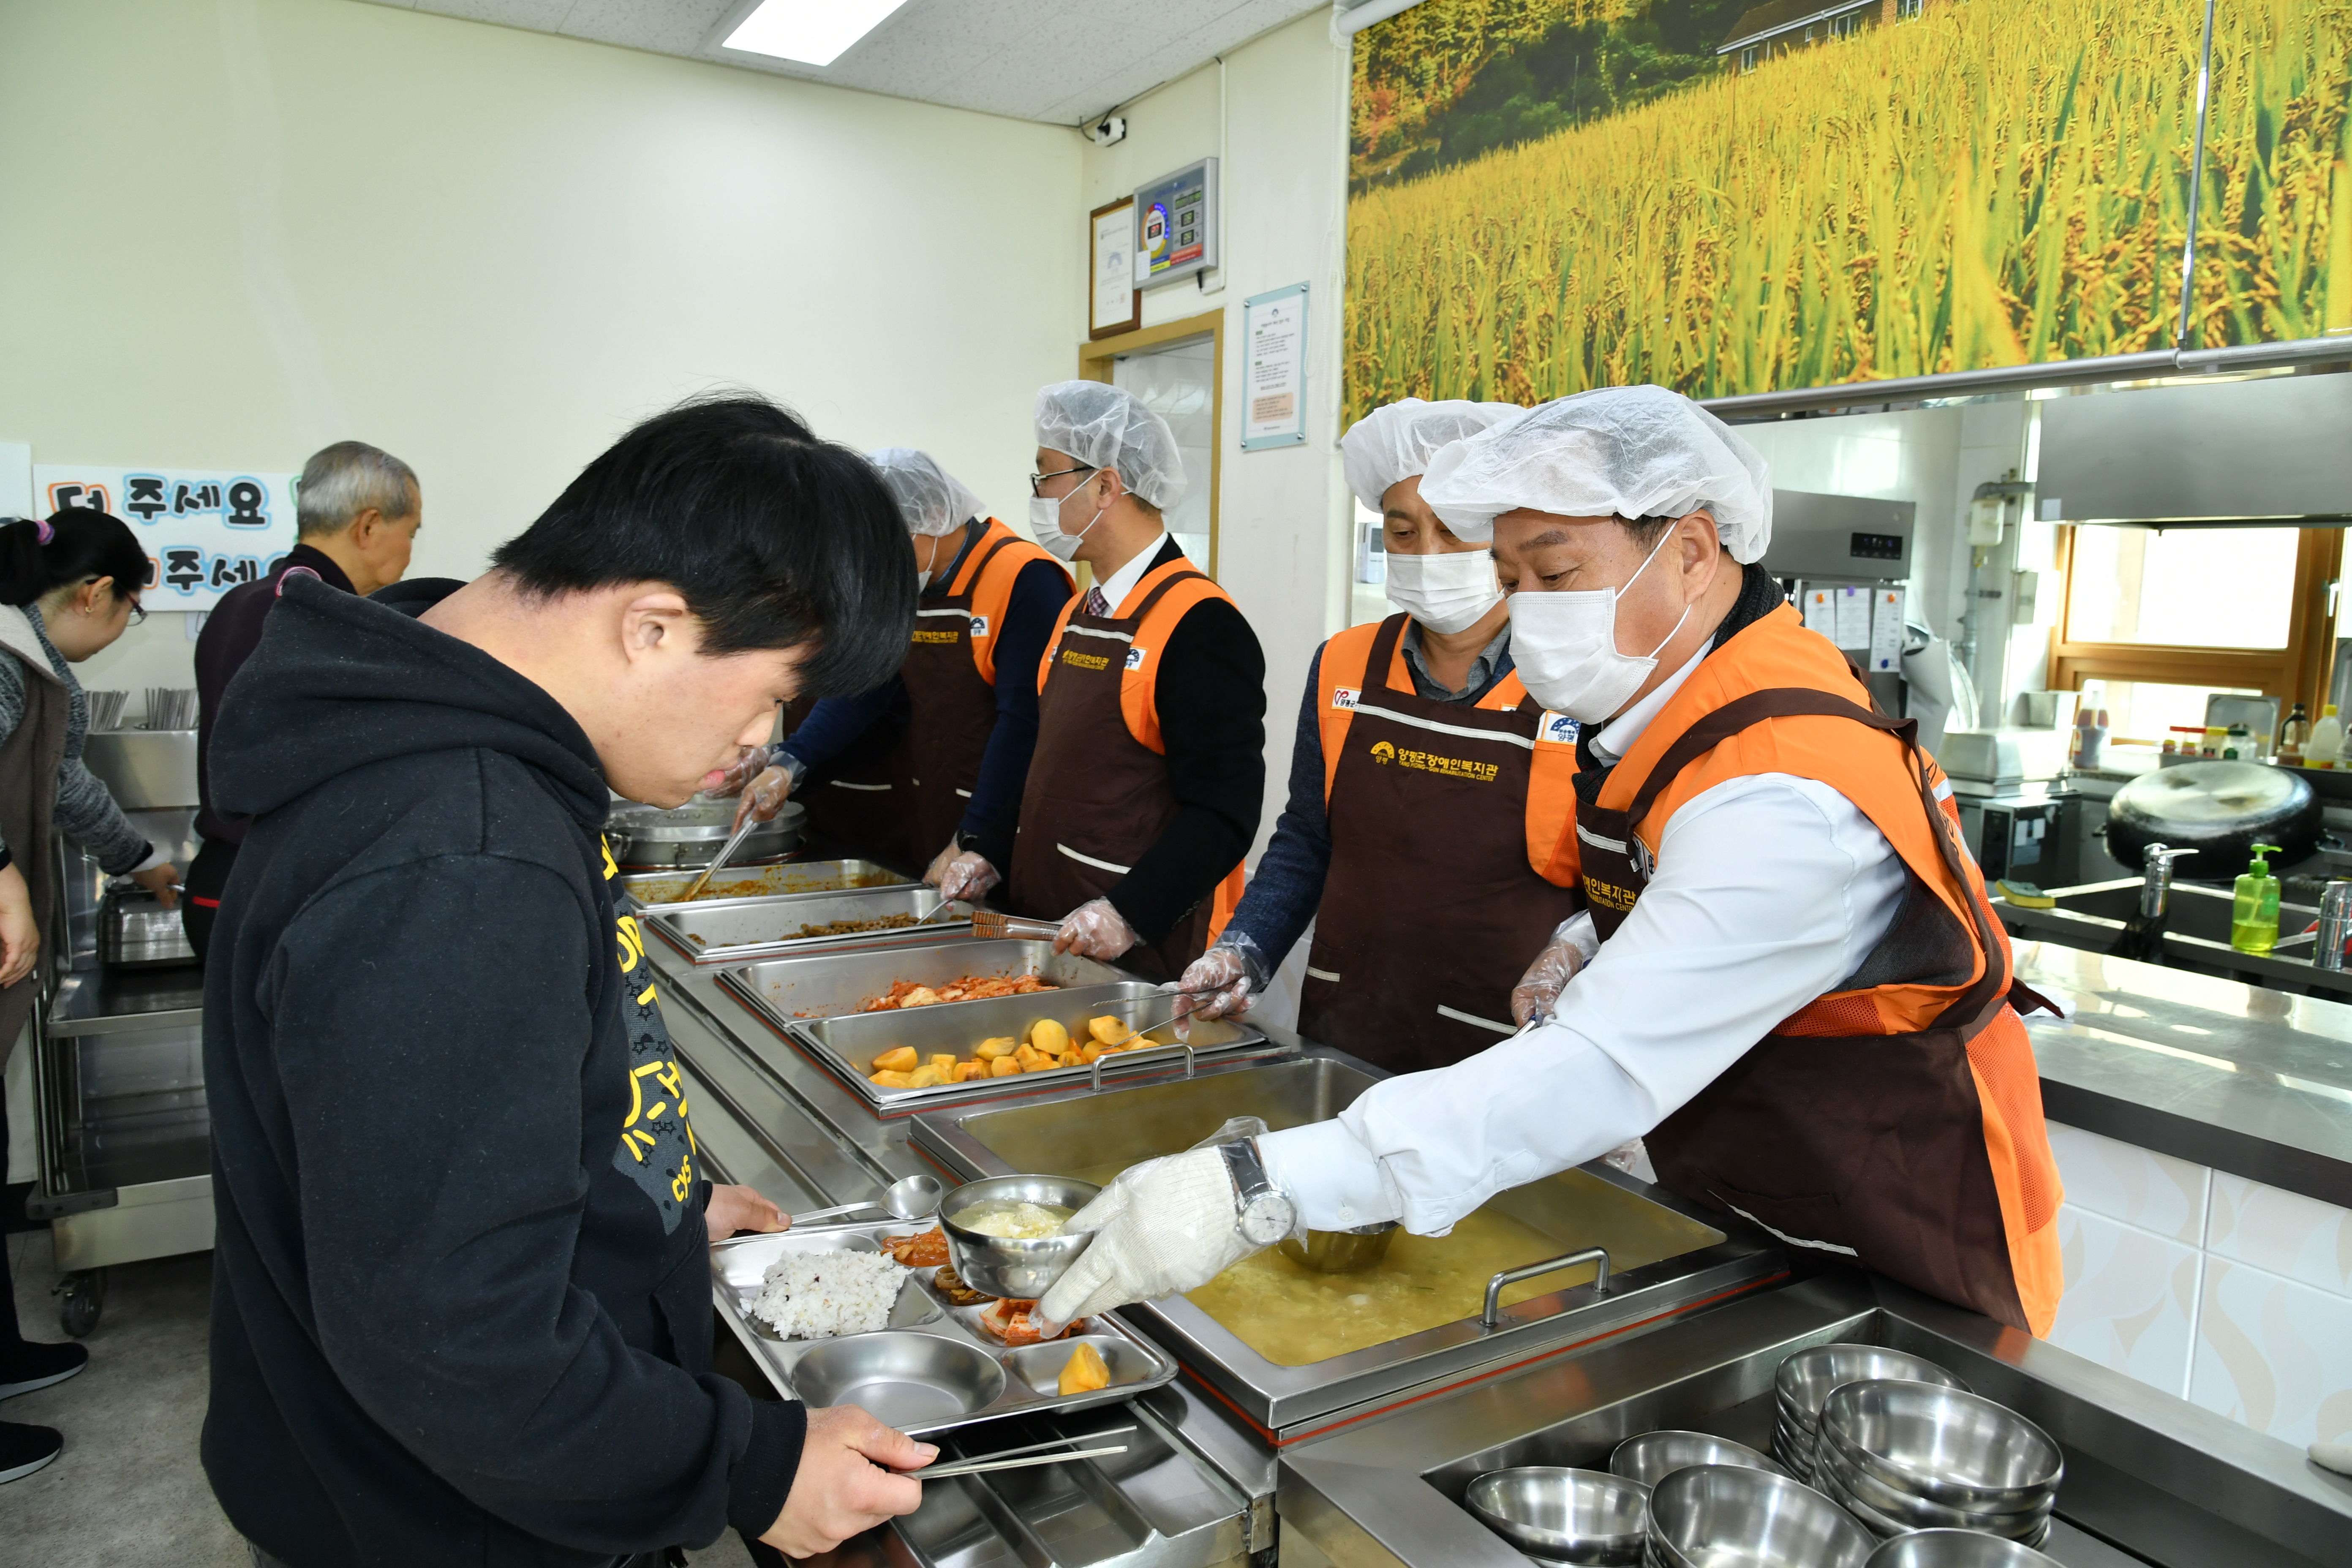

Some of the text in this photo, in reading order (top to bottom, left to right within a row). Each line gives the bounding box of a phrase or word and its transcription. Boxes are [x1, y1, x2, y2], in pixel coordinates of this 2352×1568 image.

[128, 479, 265, 525] 주세요
[1398, 748, 1499, 776] 양평군장애인복지관
[1440, 768, 1475, 779] REHABILITATION
